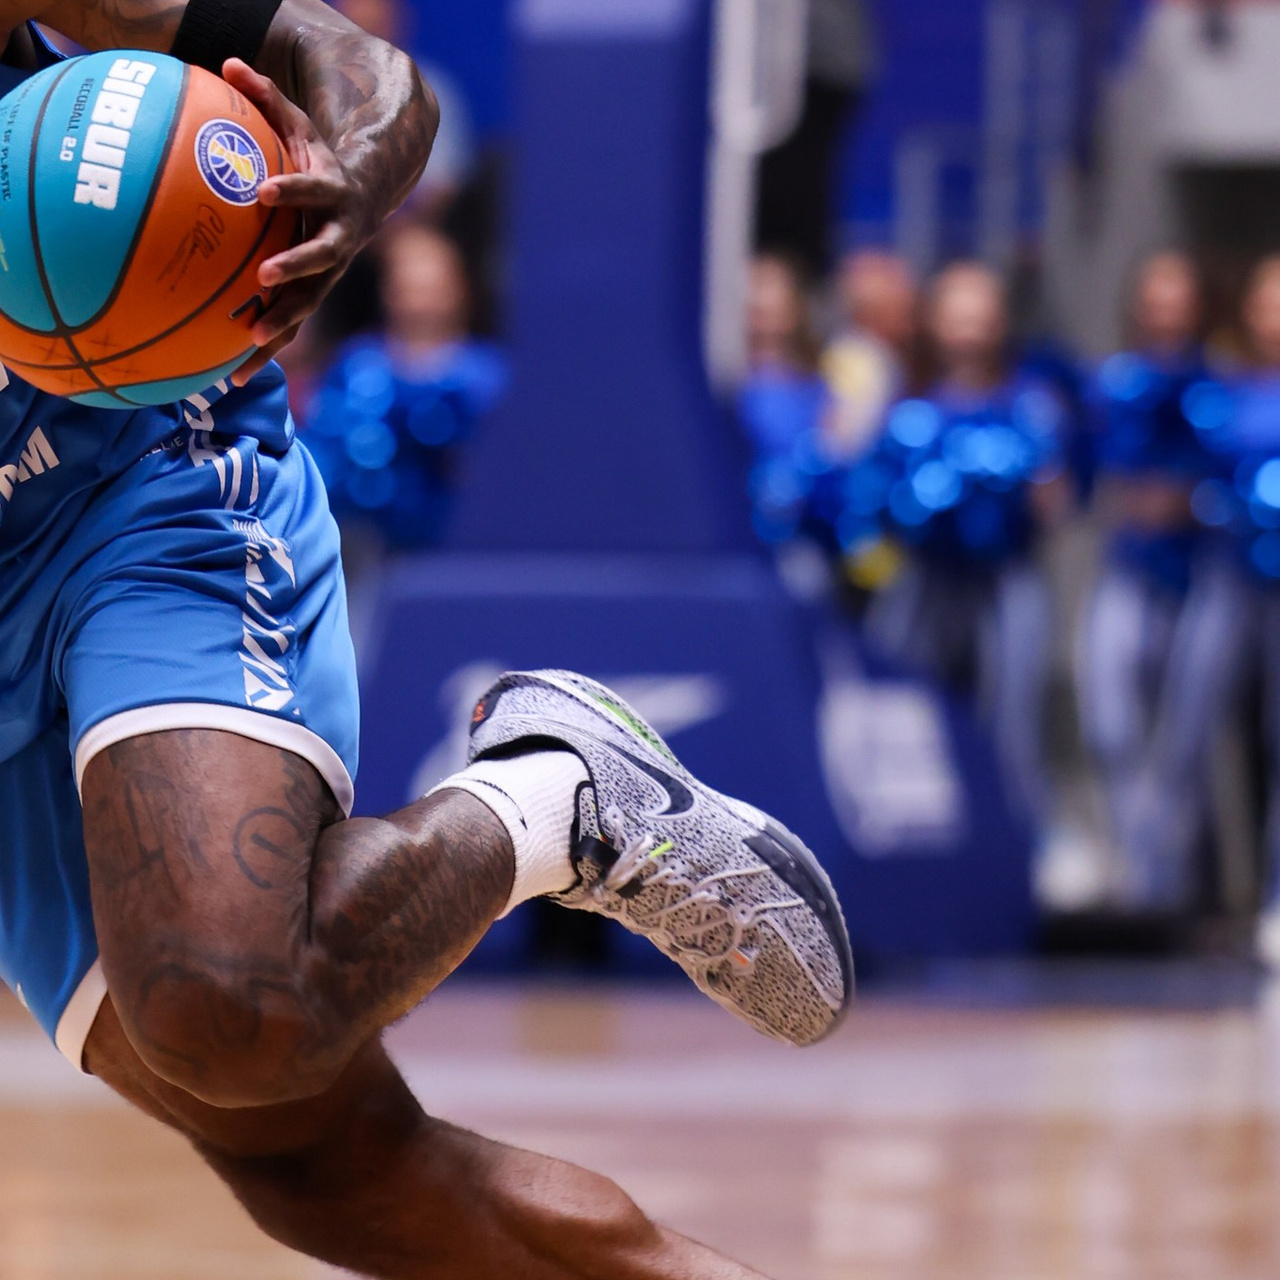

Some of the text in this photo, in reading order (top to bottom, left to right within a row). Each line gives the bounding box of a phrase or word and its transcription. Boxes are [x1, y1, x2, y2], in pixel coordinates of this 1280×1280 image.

[59, 136, 78, 162] 2.0
[73, 58, 158, 211] SIBUR
[0, 146, 13, 202] PLASTIC
